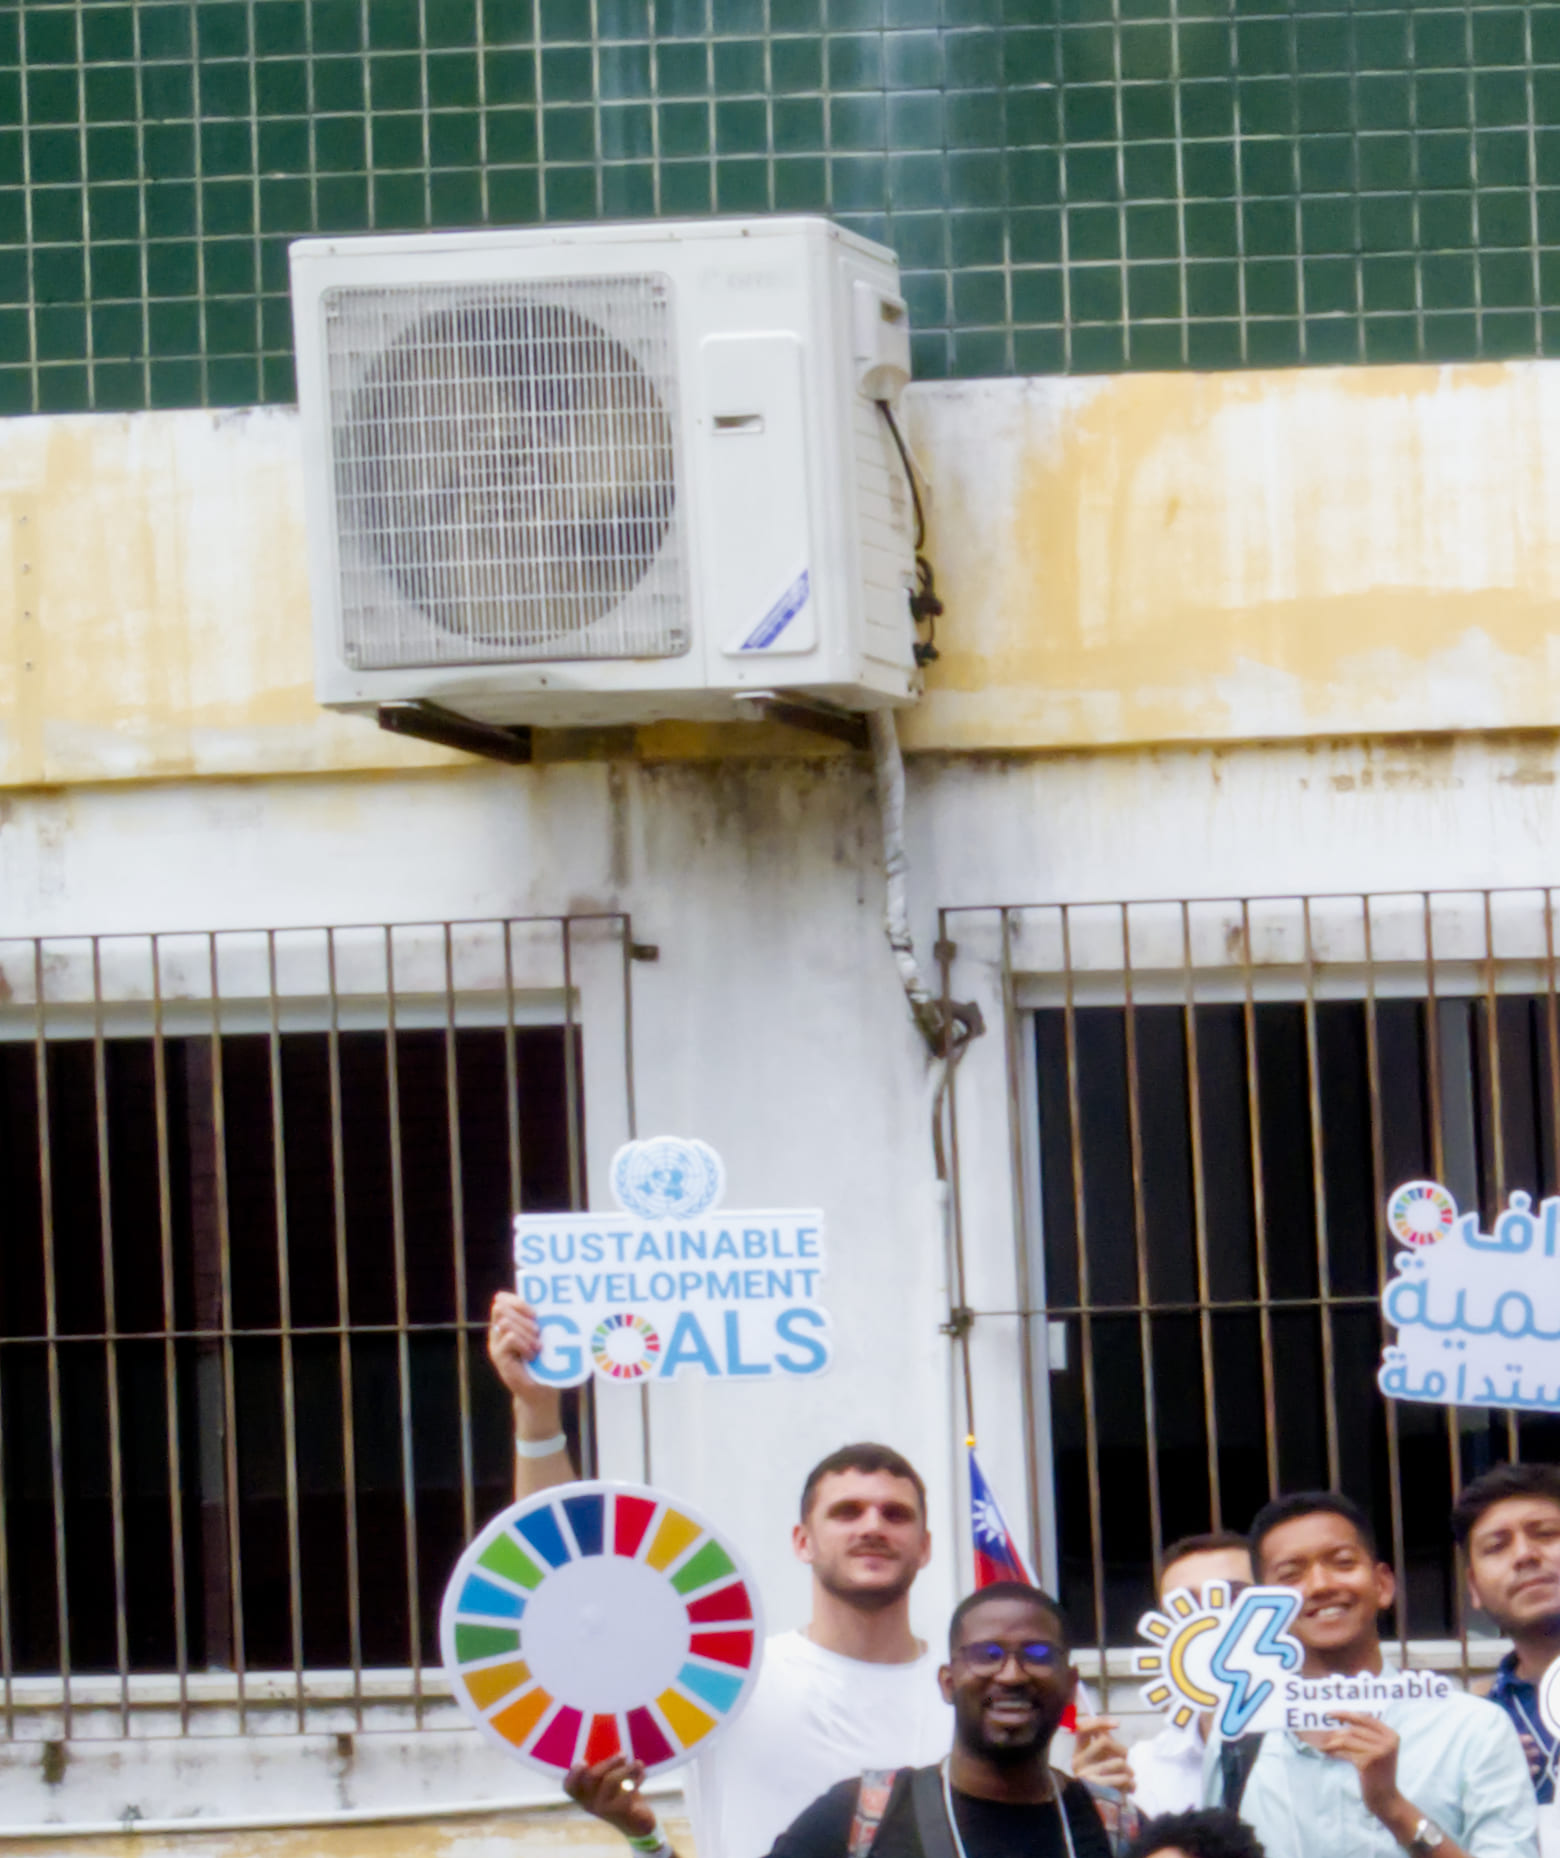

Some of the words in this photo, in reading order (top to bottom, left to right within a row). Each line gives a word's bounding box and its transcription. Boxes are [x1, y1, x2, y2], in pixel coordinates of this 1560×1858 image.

[521, 1228, 820, 1265] SUSTAINABLE
[523, 1268, 821, 1305] DEVELOPMENT
[527, 1307, 828, 1381] GOALS
[1286, 1676, 1449, 1700] Sustainable
